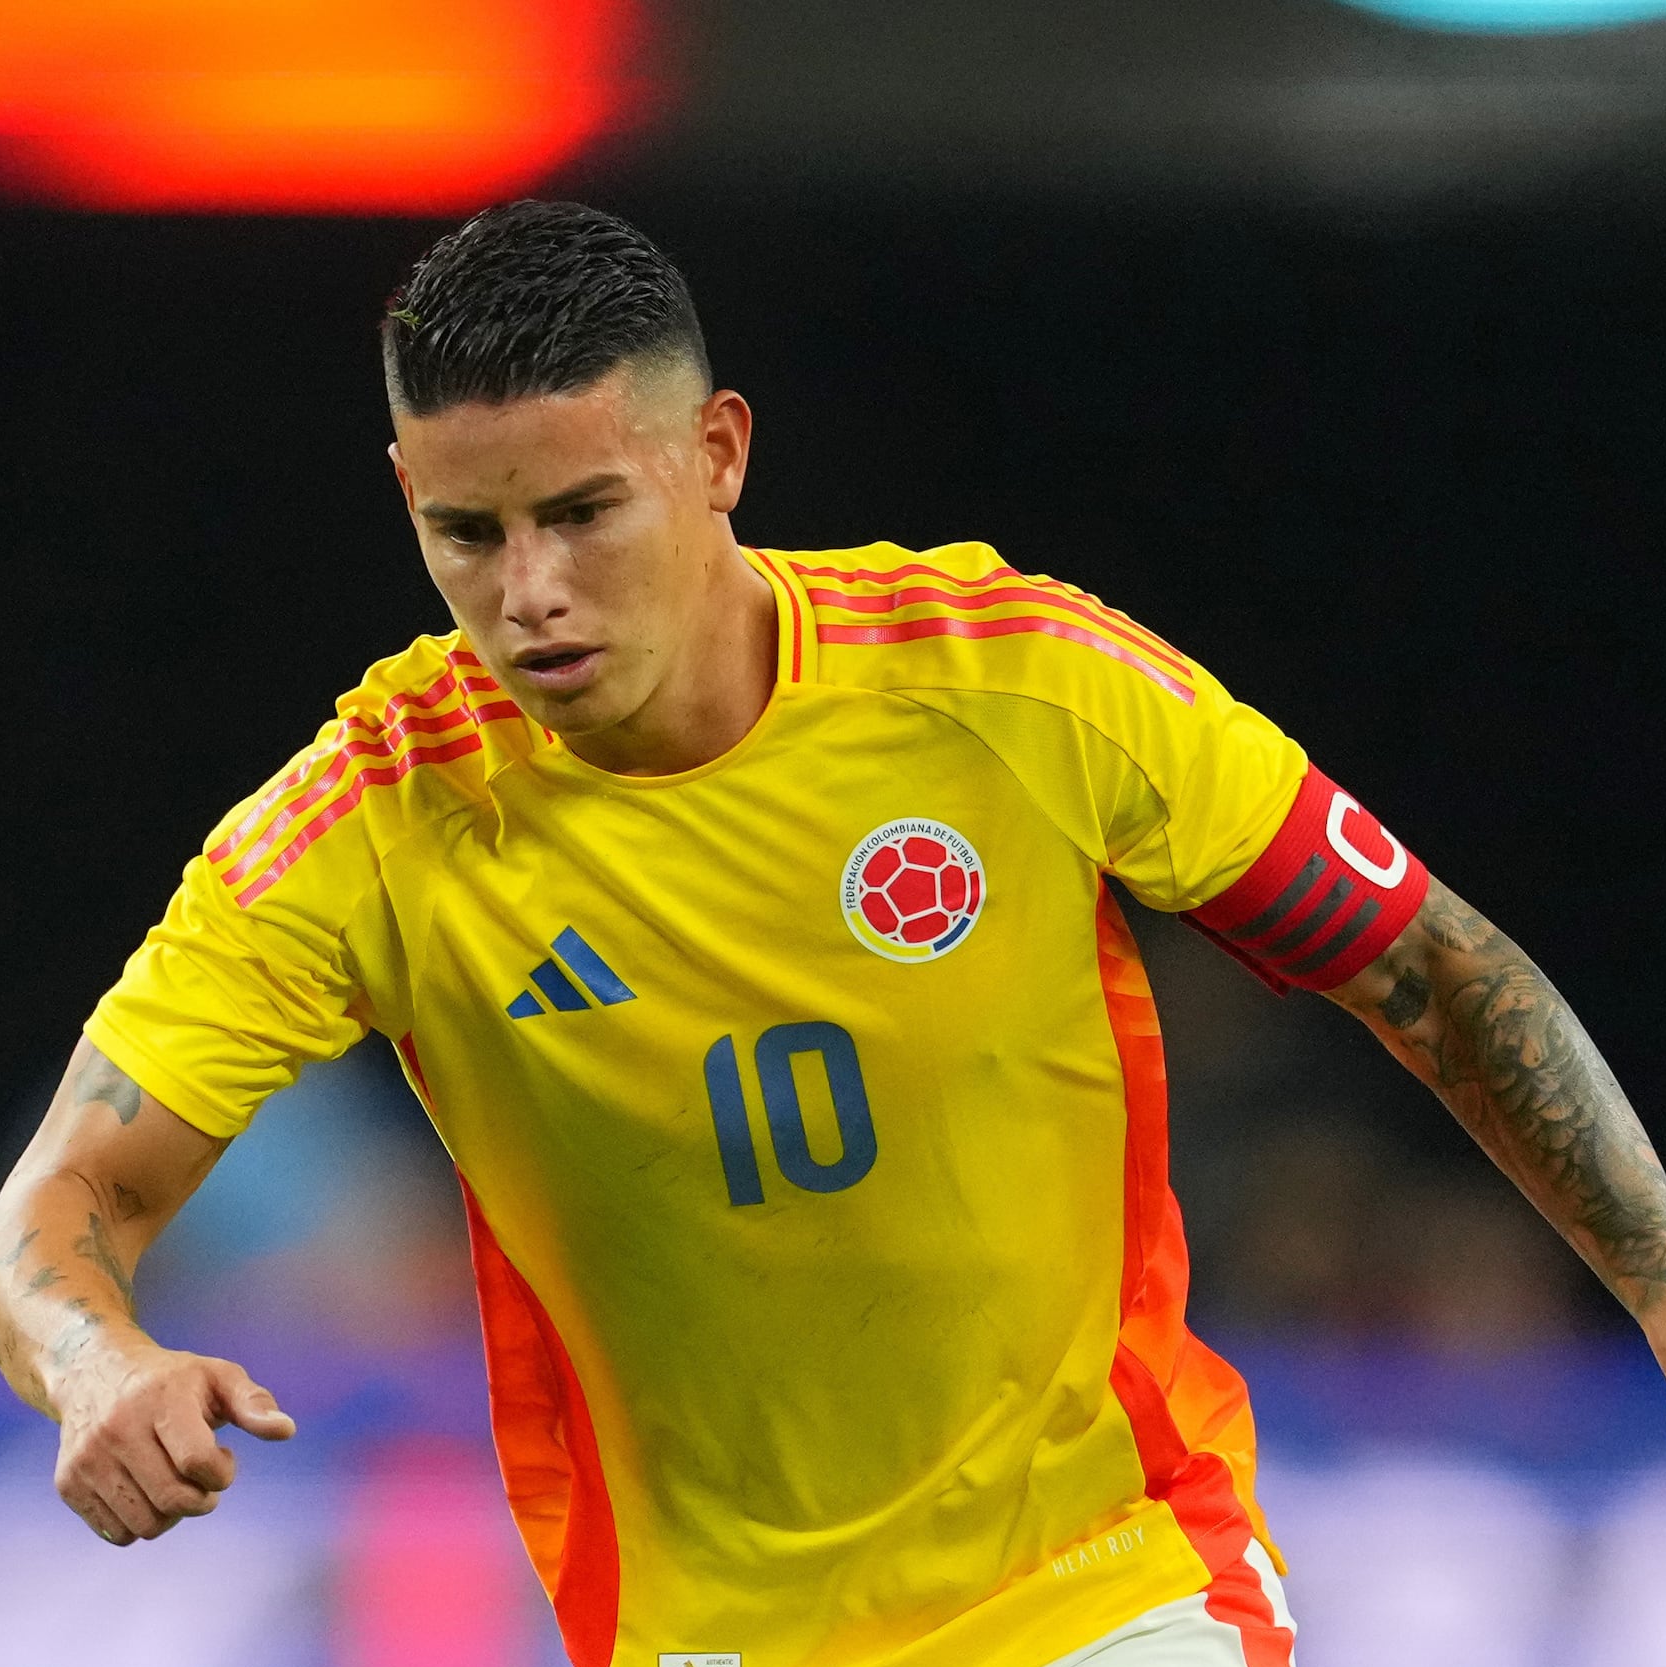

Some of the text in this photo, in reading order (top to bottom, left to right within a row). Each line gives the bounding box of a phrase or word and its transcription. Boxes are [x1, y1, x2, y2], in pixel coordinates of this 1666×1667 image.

[846, 823, 976, 909] FEDERACION COLOMBIANA DE FUTBOL
[1326, 791, 1408, 890] C
[703, 1020, 878, 1206] 10
[1051, 1525, 1146, 1579] HEAT.RDY
